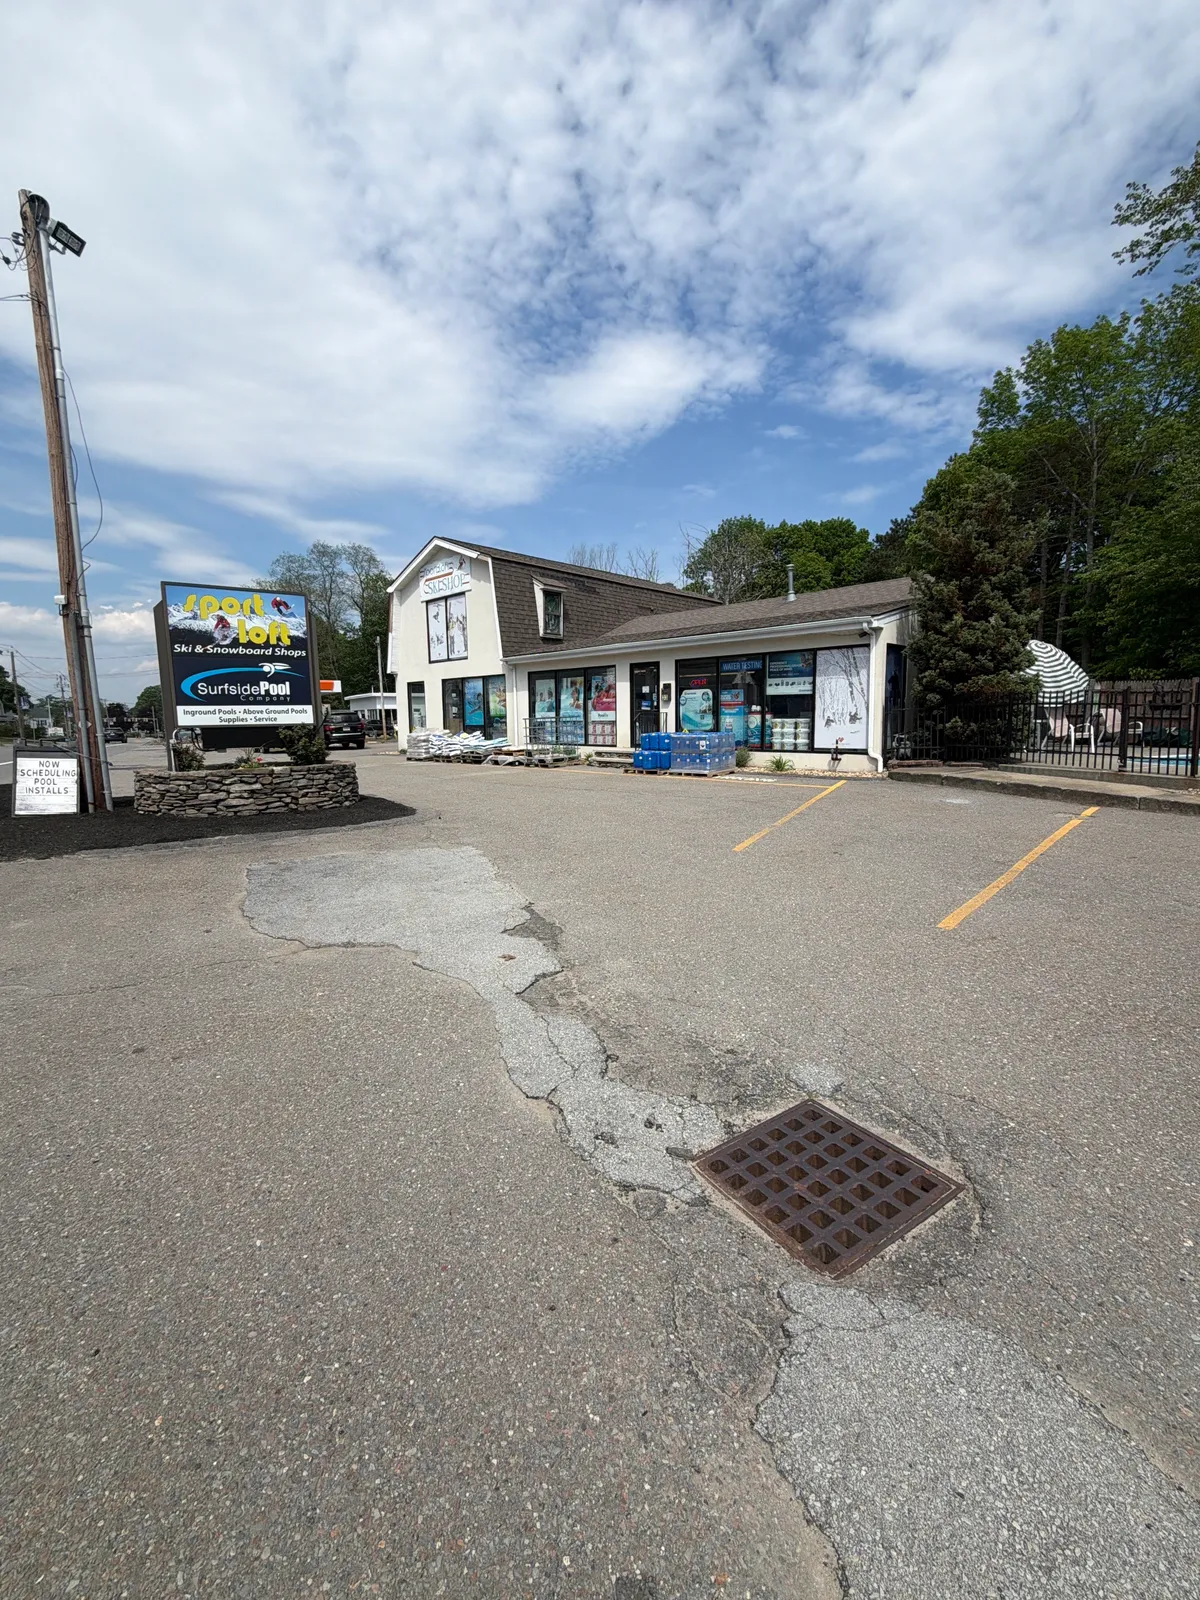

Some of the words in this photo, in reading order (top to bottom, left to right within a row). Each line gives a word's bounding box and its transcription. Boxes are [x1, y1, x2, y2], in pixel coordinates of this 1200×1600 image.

[183, 594, 265, 620] sport
[237, 619, 291, 646] loft
[173, 643, 192, 653] Ski
[195, 644, 204, 653] &
[206, 645, 272, 656] Snowboard
[274, 647, 307, 658] Shops
[723, 662, 740, 670] WATER
[183, 708, 216, 717] Inground
[218, 716, 249, 724] Supplies
[38, 760, 60, 768] NOW
[20, 768, 76, 777] SCHEDULING
[34, 777, 58, 786] POOL
[25, 786, 69, 795] INSTALLS
